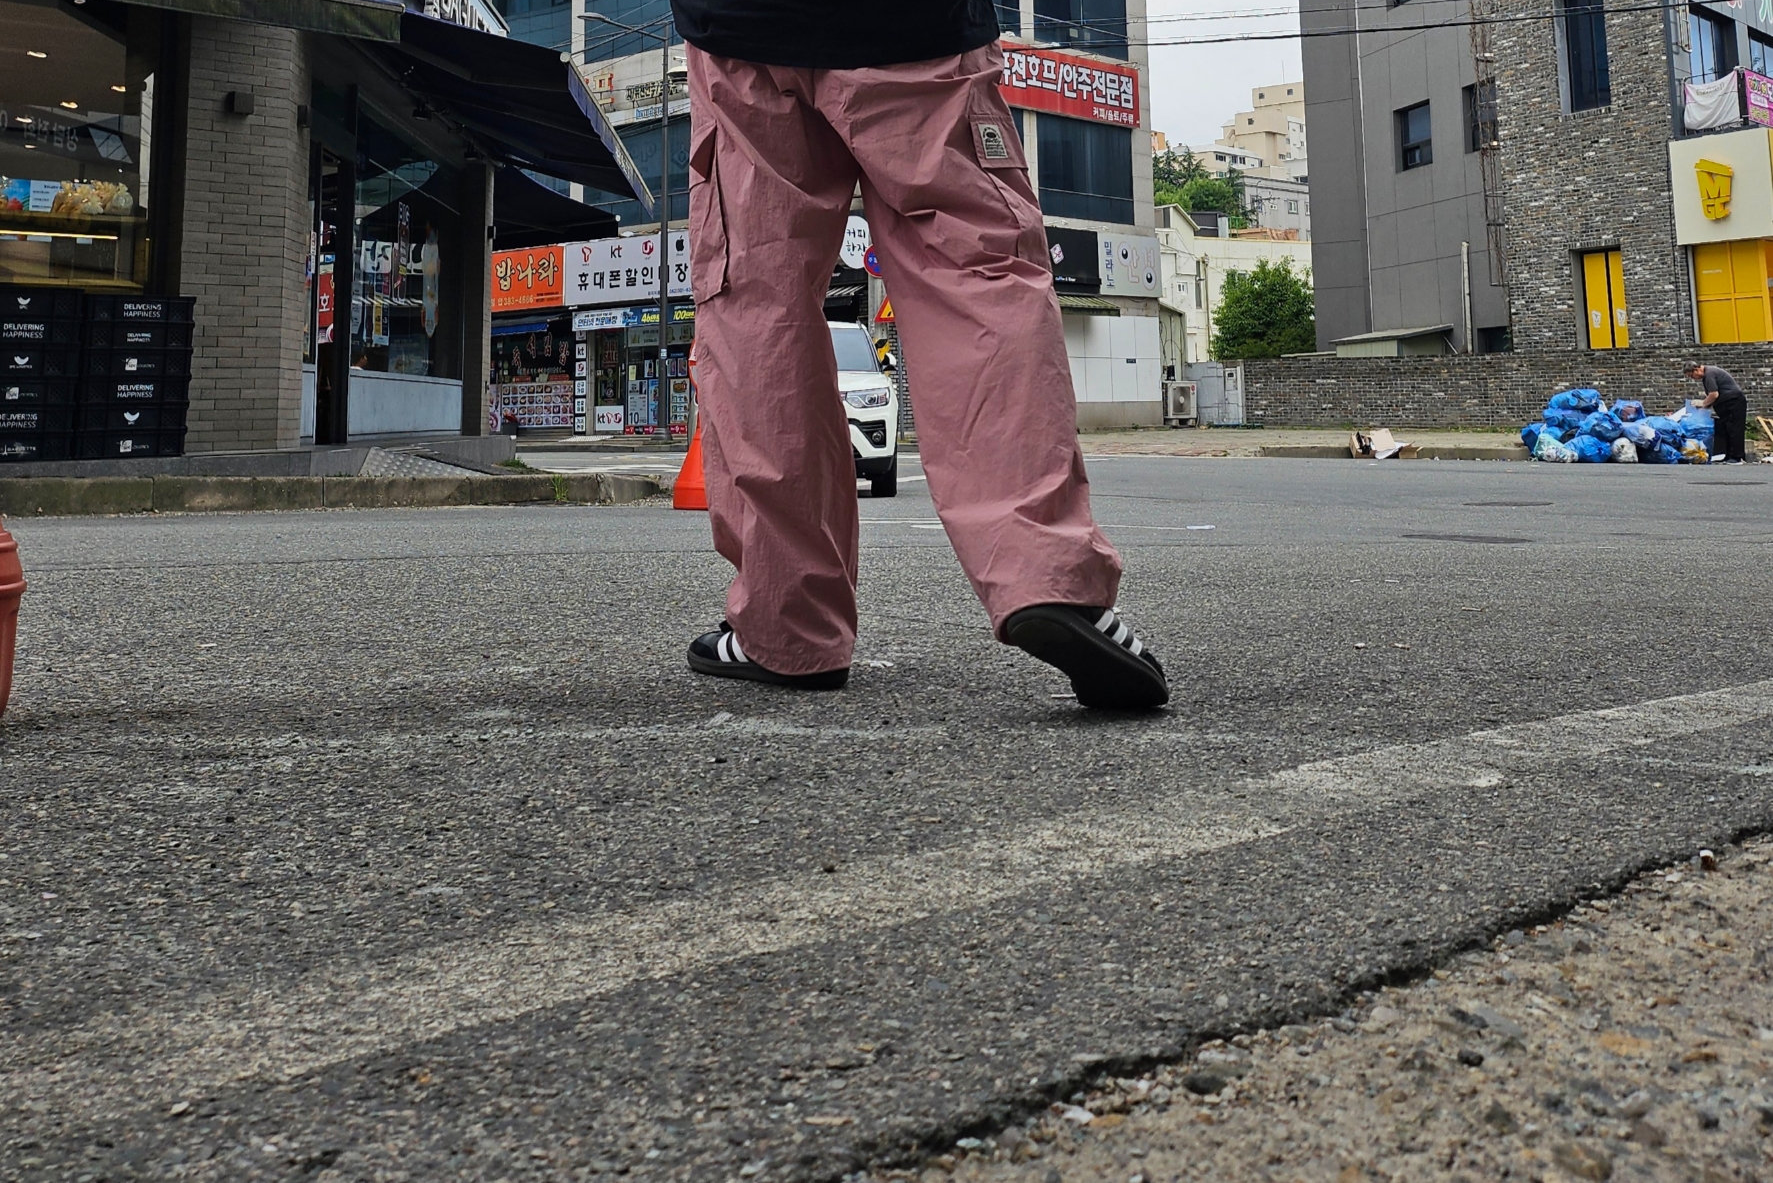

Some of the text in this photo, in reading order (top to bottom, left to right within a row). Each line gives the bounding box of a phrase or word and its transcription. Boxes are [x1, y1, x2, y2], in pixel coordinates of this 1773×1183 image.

[846, 228, 866, 238] 커피
[611, 245, 622, 258] kt
[495, 251, 559, 292] 밥나라
[124, 303, 162, 311] DELIVERING
[3, 323, 45, 331] DELIVERING
[2, 331, 44, 339] HAPPINESS
[577, 347, 585, 356] kt
[597, 413, 606, 424] kt
